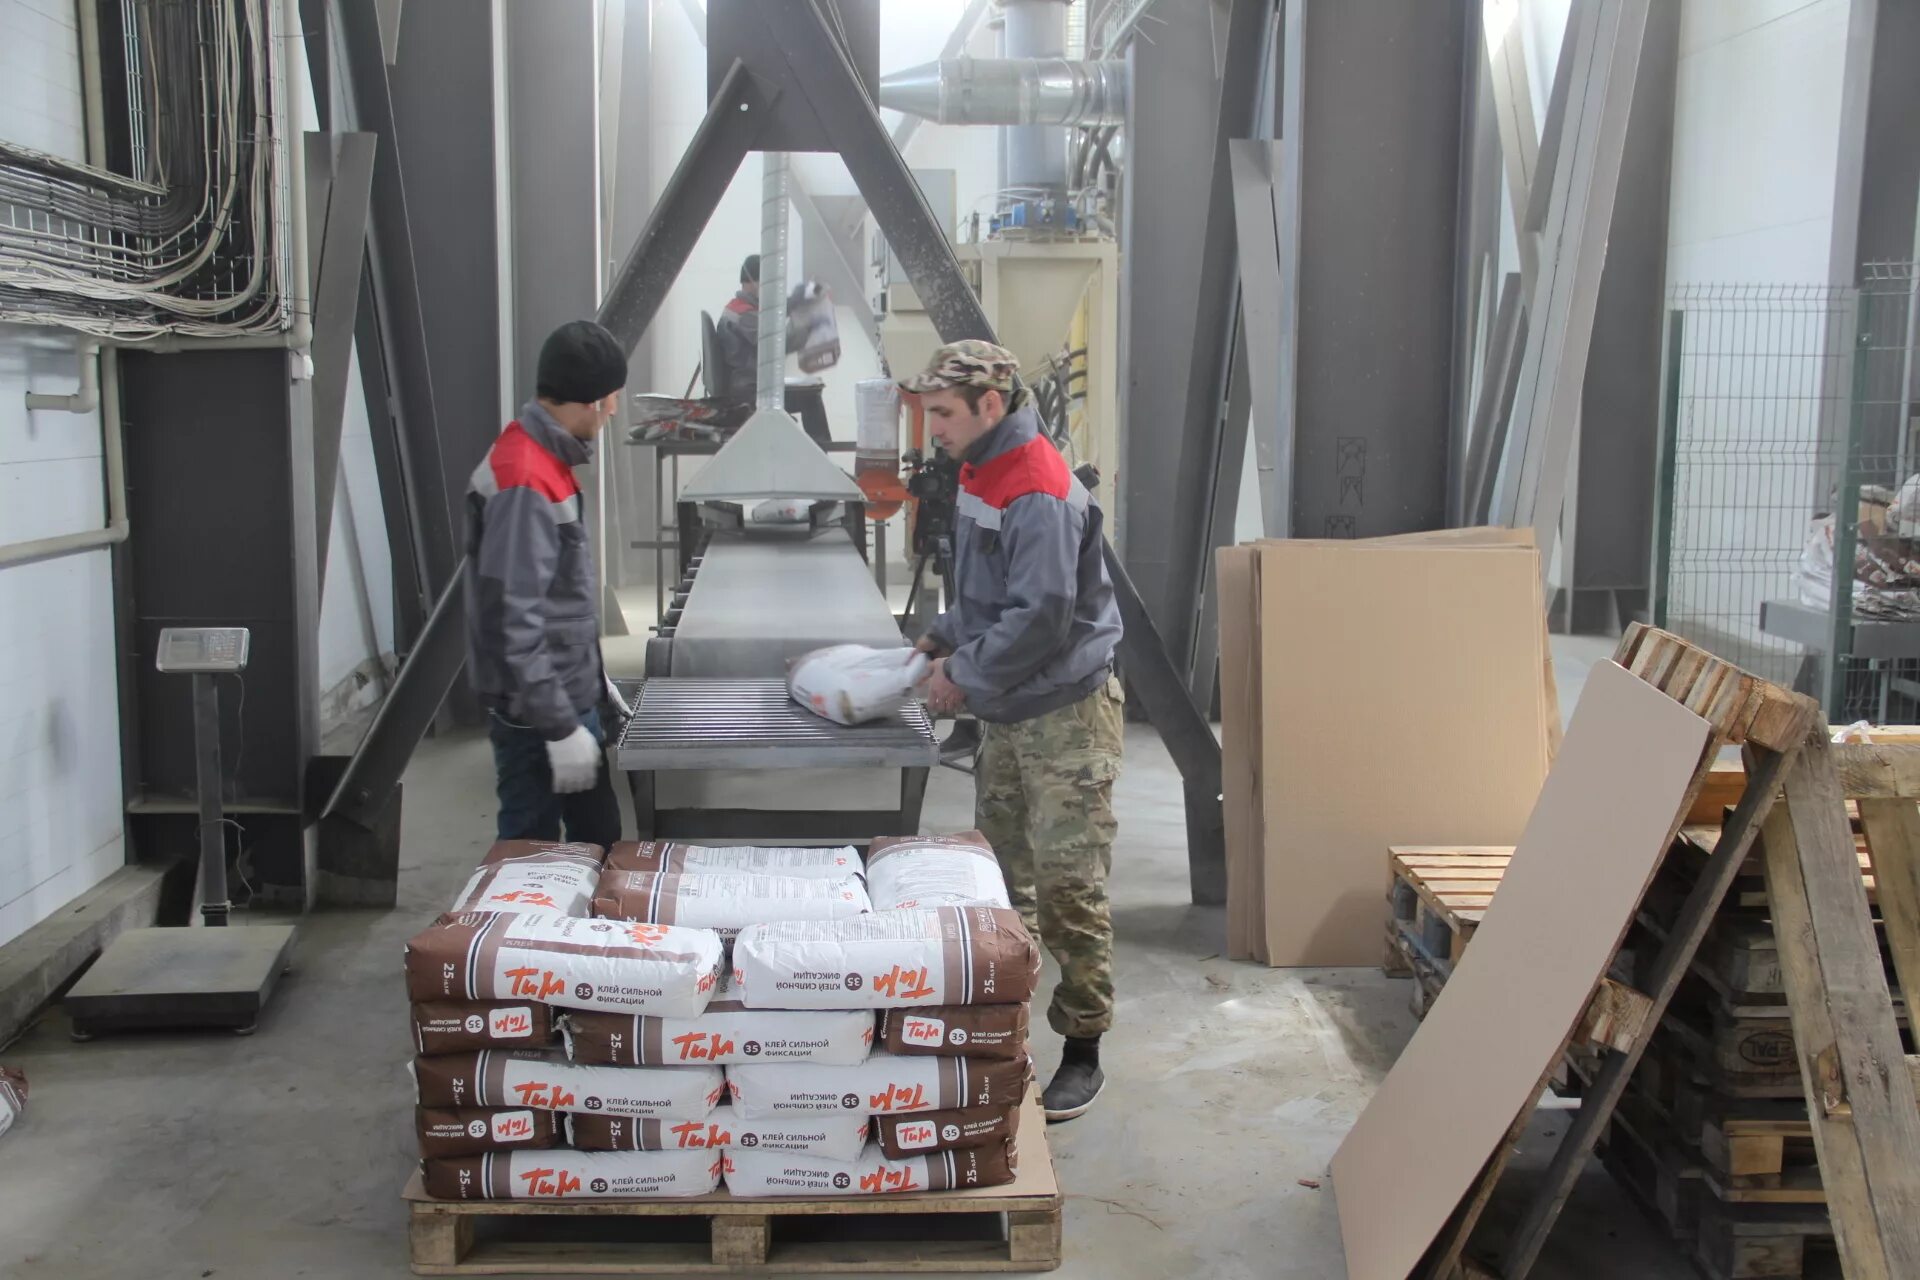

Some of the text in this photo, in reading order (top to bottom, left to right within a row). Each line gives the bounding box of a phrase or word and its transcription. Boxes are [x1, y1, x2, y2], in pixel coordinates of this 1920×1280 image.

[443, 963, 455, 979] 25
[792, 971, 841, 980] ФИКСАЦИИ
[597, 984, 663, 997] КЛЕЙ СИЛЬНОЙ
[776, 980, 841, 991] КЛЕЙ СИЛЬНОЙ
[984, 979, 995, 994] 25
[596, 995, 645, 1006] ФИКСАЦИИ
[468, 1019, 481, 1029] 35
[610, 1033, 622, 1049] 25
[951, 1032, 964, 1042] 35
[764, 1038, 830, 1049] КЛЕЙ СИЛЬНОЙ
[764, 1049, 812, 1057] ФИКСАЦИИ
[452, 1078, 464, 1094] 25
[606, 1096, 672, 1107] КЛЕЙ СИЛЬНОЙ
[789, 1093, 838, 1102] ФИКСАЦИИ
[978, 1093, 990, 1105] 25
[606, 1106, 655, 1115] ФИКСАЦИИ
[773, 1102, 838, 1112] КЛЕЙ СИЛЬНОЙ
[471, 1124, 484, 1134] 35
[610, 1121, 622, 1136] 25
[945, 1128, 957, 1138] 35
[762, 1132, 827, 1142] КЛЕЙ СИЛЬНОЙ
[762, 1142, 809, 1150] ФИКСАЦИИ
[459, 1169, 471, 1185] 25
[783, 1169, 830, 1178] ФИКСАЦИИ
[967, 1170, 977, 1183] 25
[611, 1173, 676, 1186] КЛЕЙ СИЛЬНОЙ
[766, 1176, 830, 1188] КЛЕЙ СИЛЬНОЙ
[611, 1185, 660, 1193] ФИКСАЦИИ
